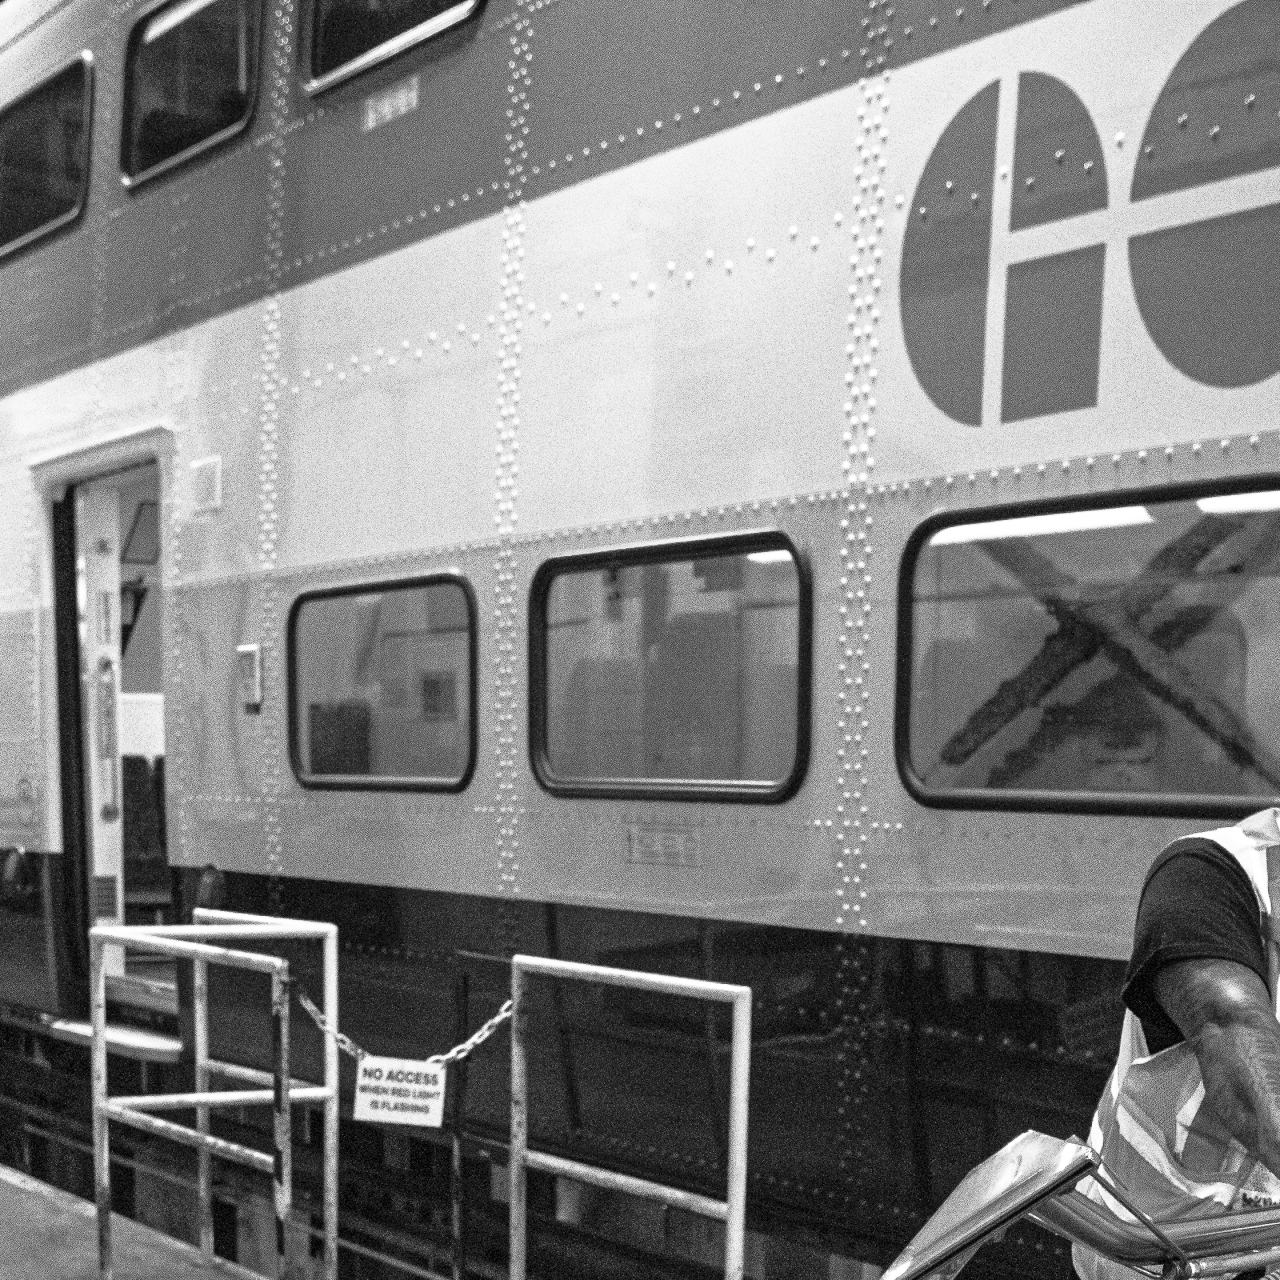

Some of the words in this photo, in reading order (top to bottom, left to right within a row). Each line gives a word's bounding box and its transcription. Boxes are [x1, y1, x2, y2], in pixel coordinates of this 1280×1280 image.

[362, 1067, 383, 1081] NO
[386, 1069, 439, 1086] ACCESS
[358, 1084, 389, 1095] WHEN
[390, 1086, 411, 1098] RED
[369, 1099, 379, 1110] IS
[381, 1101, 430, 1114] FLASHING
